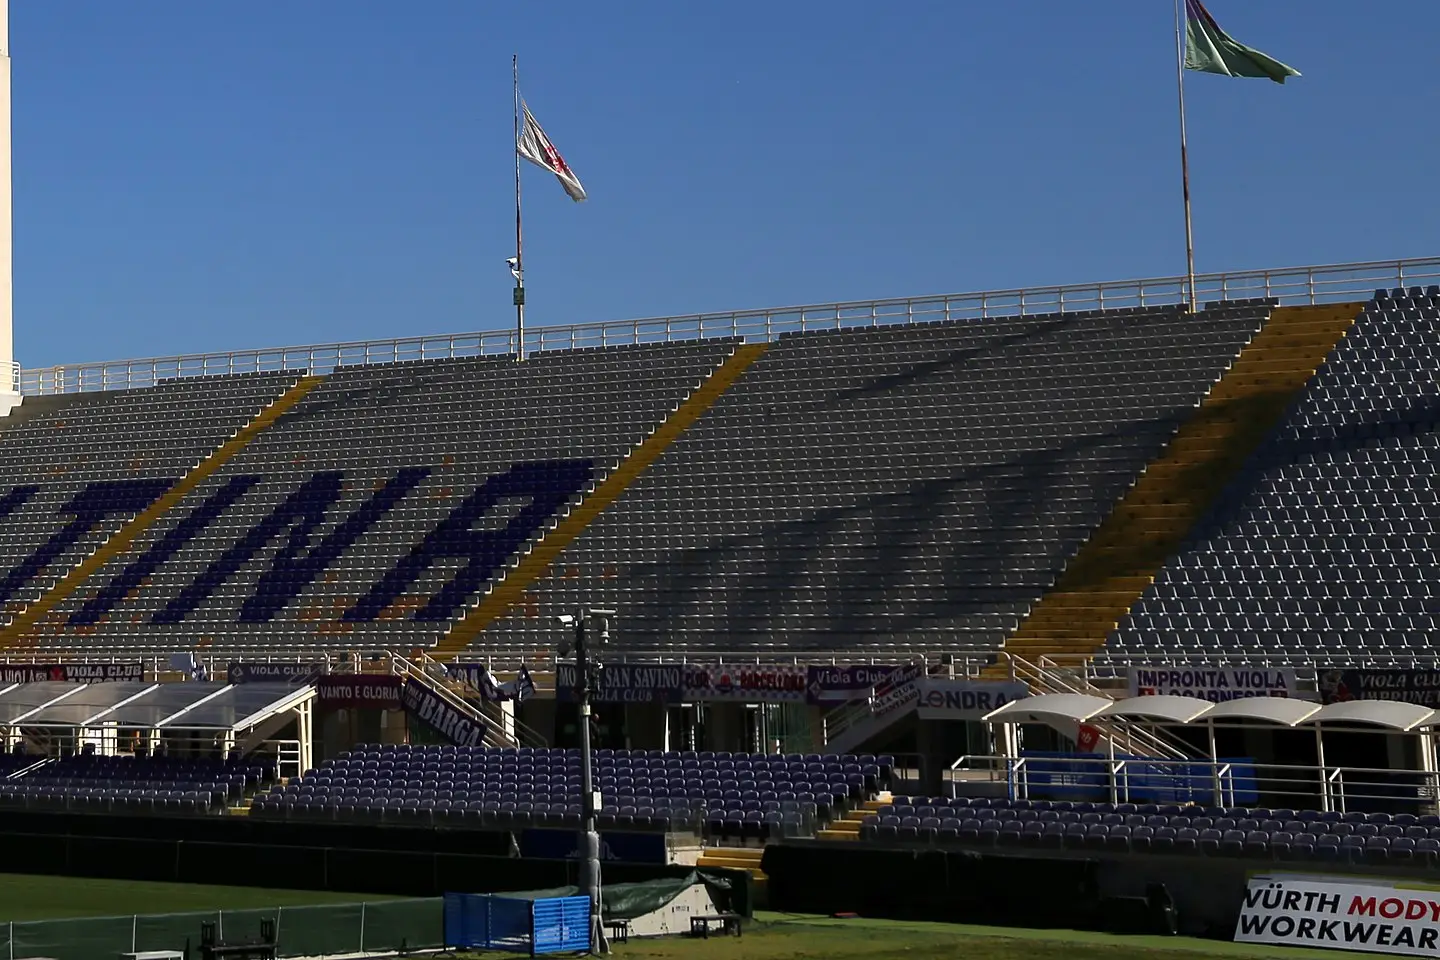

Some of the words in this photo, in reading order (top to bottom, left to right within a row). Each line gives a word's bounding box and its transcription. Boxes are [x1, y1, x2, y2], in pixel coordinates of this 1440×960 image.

[66, 665, 104, 677] VIOLA
[107, 665, 142, 677] CLUB
[250, 665, 281, 676] VIOLA
[283, 665, 312, 676] CLUB
[605, 667, 631, 688] SAN
[634, 667, 680, 688] SAVINO
[817, 670, 851, 684] Viola
[1137, 670, 1229, 688] IMPRONTA
[1233, 670, 1287, 689] VIOLA
[1358, 673, 1408, 688] VIOLA
[320, 685, 352, 700] VANTO
[355, 685, 361, 699] E
[363, 685, 400, 701] GLORIA
[418, 693, 482, 747] BARGA
[1240, 914, 1439, 950] WORKWEAR
